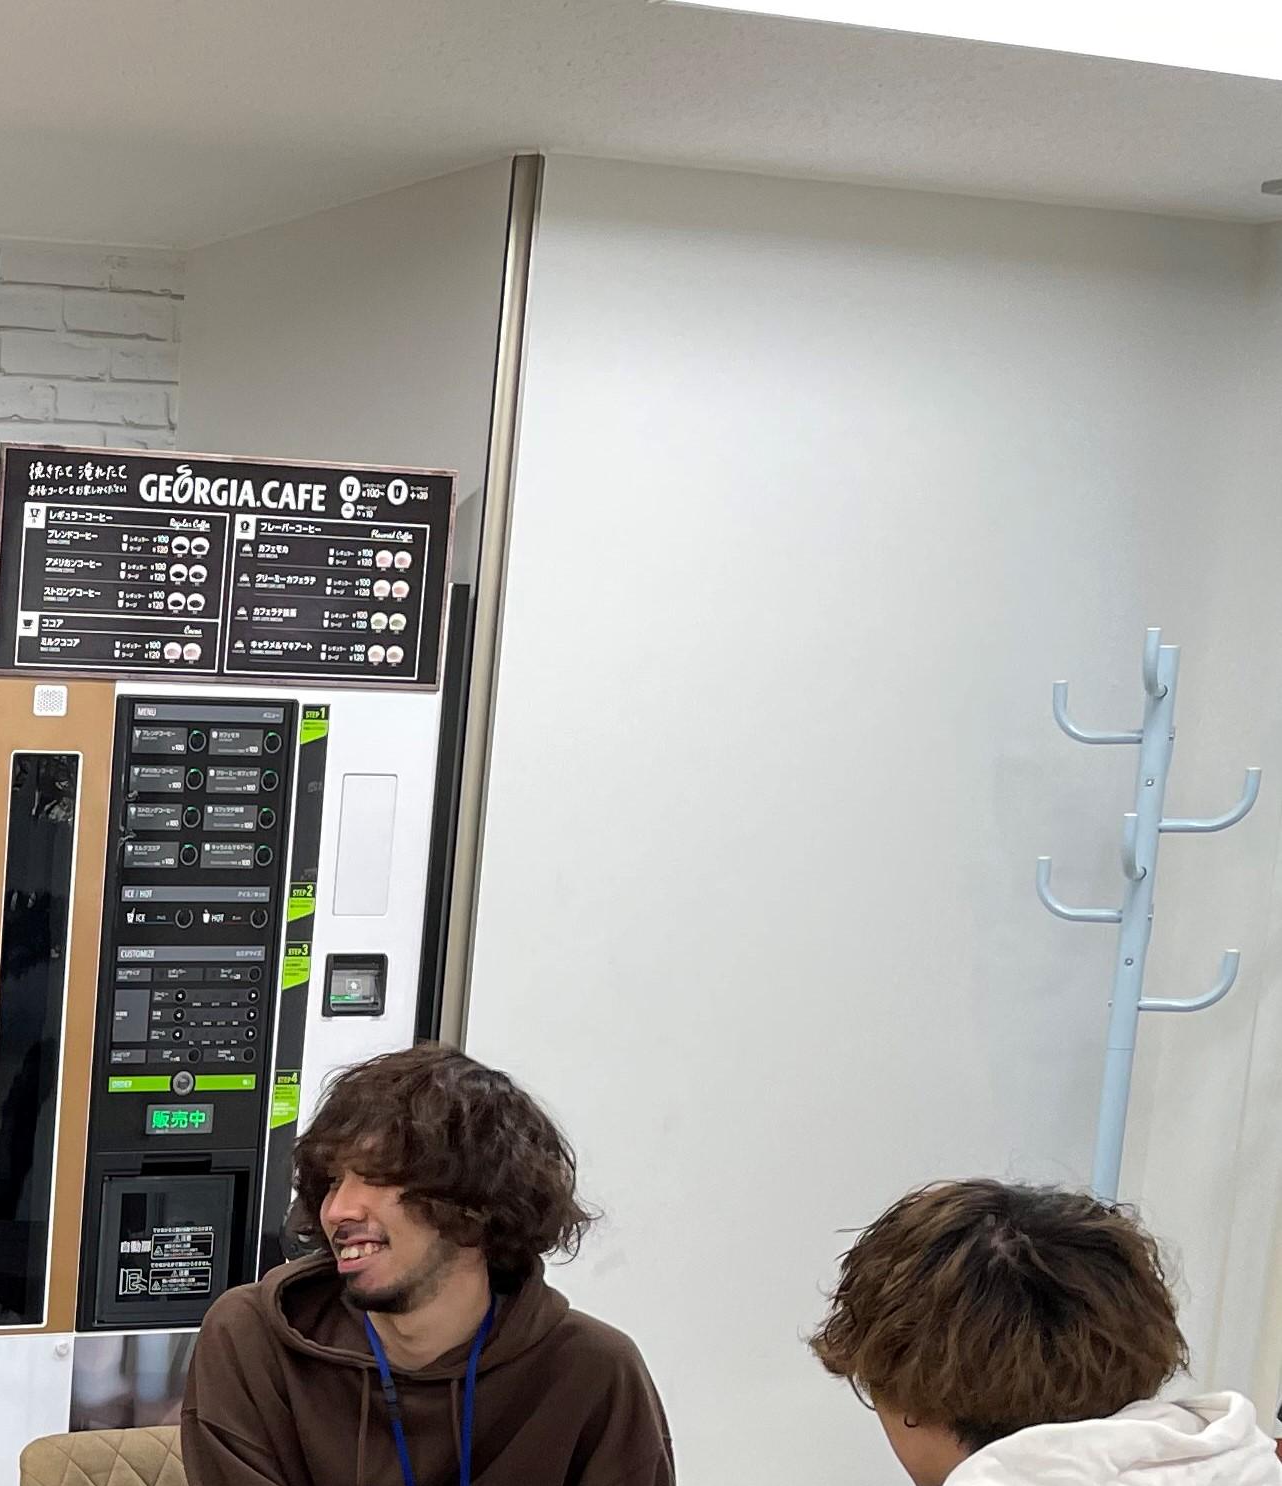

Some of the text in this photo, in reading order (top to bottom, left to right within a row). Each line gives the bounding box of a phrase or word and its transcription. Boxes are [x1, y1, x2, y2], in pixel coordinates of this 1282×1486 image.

[49, 510, 113, 522] レギュラーコーヒー
[258, 544, 288, 554] カフェモカ
[42, 619, 63, 627] ココア
[152, 1110, 206, 1128] 販売中
